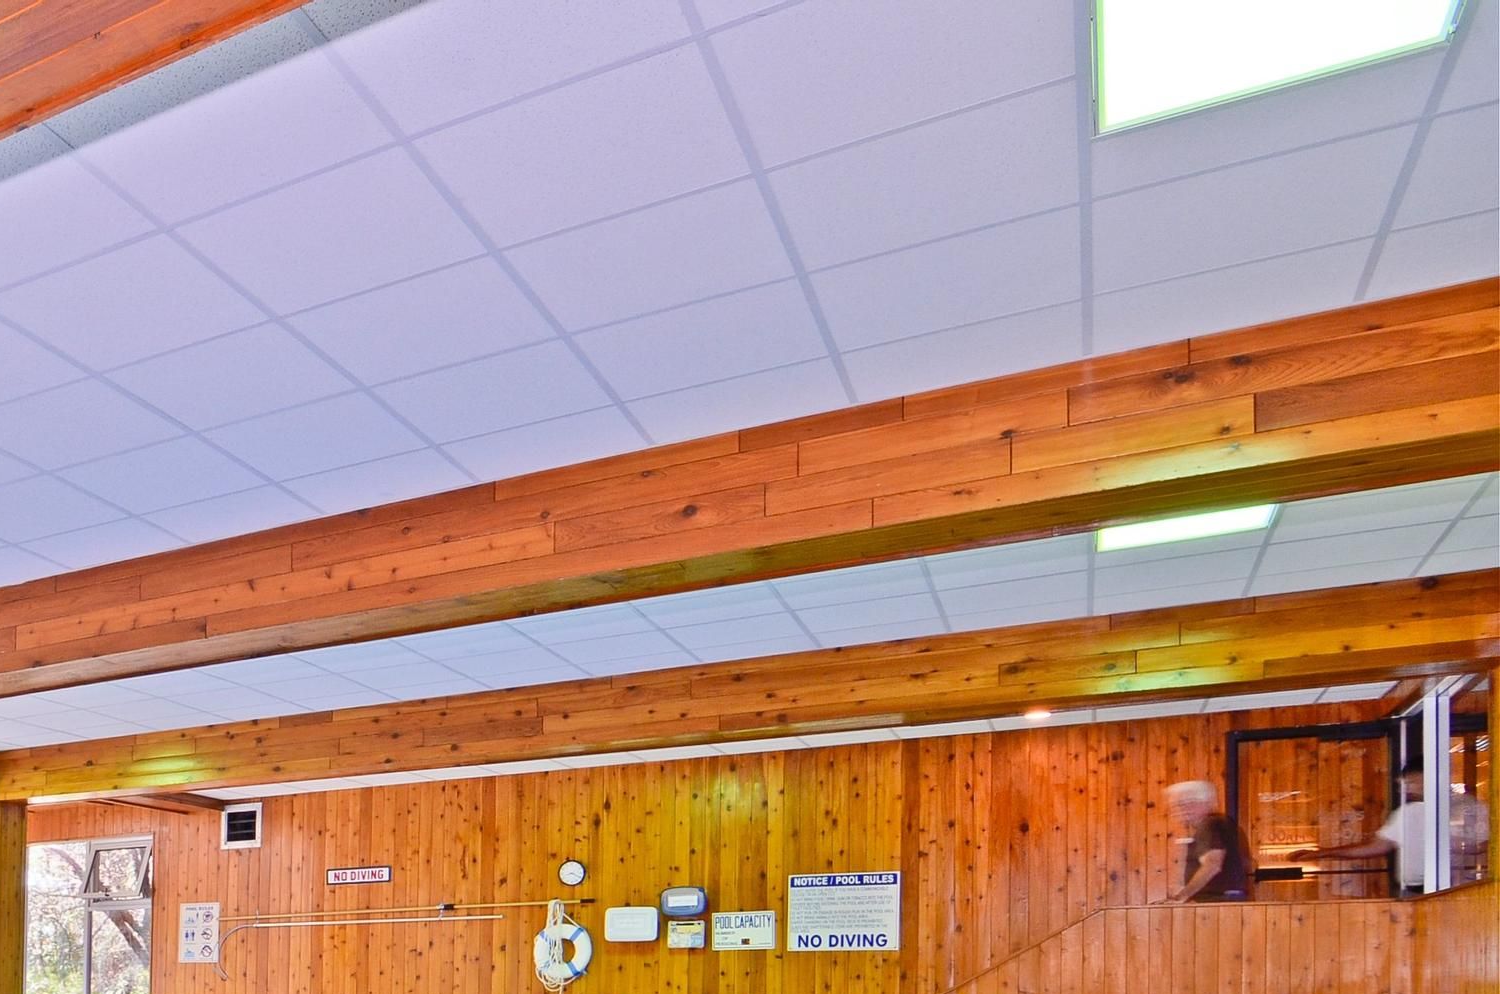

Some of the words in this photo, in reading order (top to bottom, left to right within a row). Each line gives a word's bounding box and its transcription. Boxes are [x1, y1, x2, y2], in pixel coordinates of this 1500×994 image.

[334, 872, 348, 882] NO
[350, 870, 384, 881] DIVING
[793, 876, 828, 886] NOTICE
[836, 876, 861, 885] POOL
[863, 874, 894, 884] RULES
[715, 916, 734, 929] POOL
[735, 914, 772, 929] CAPACITY
[798, 934, 822, 948] NO
[829, 934, 888, 948] DIVING
